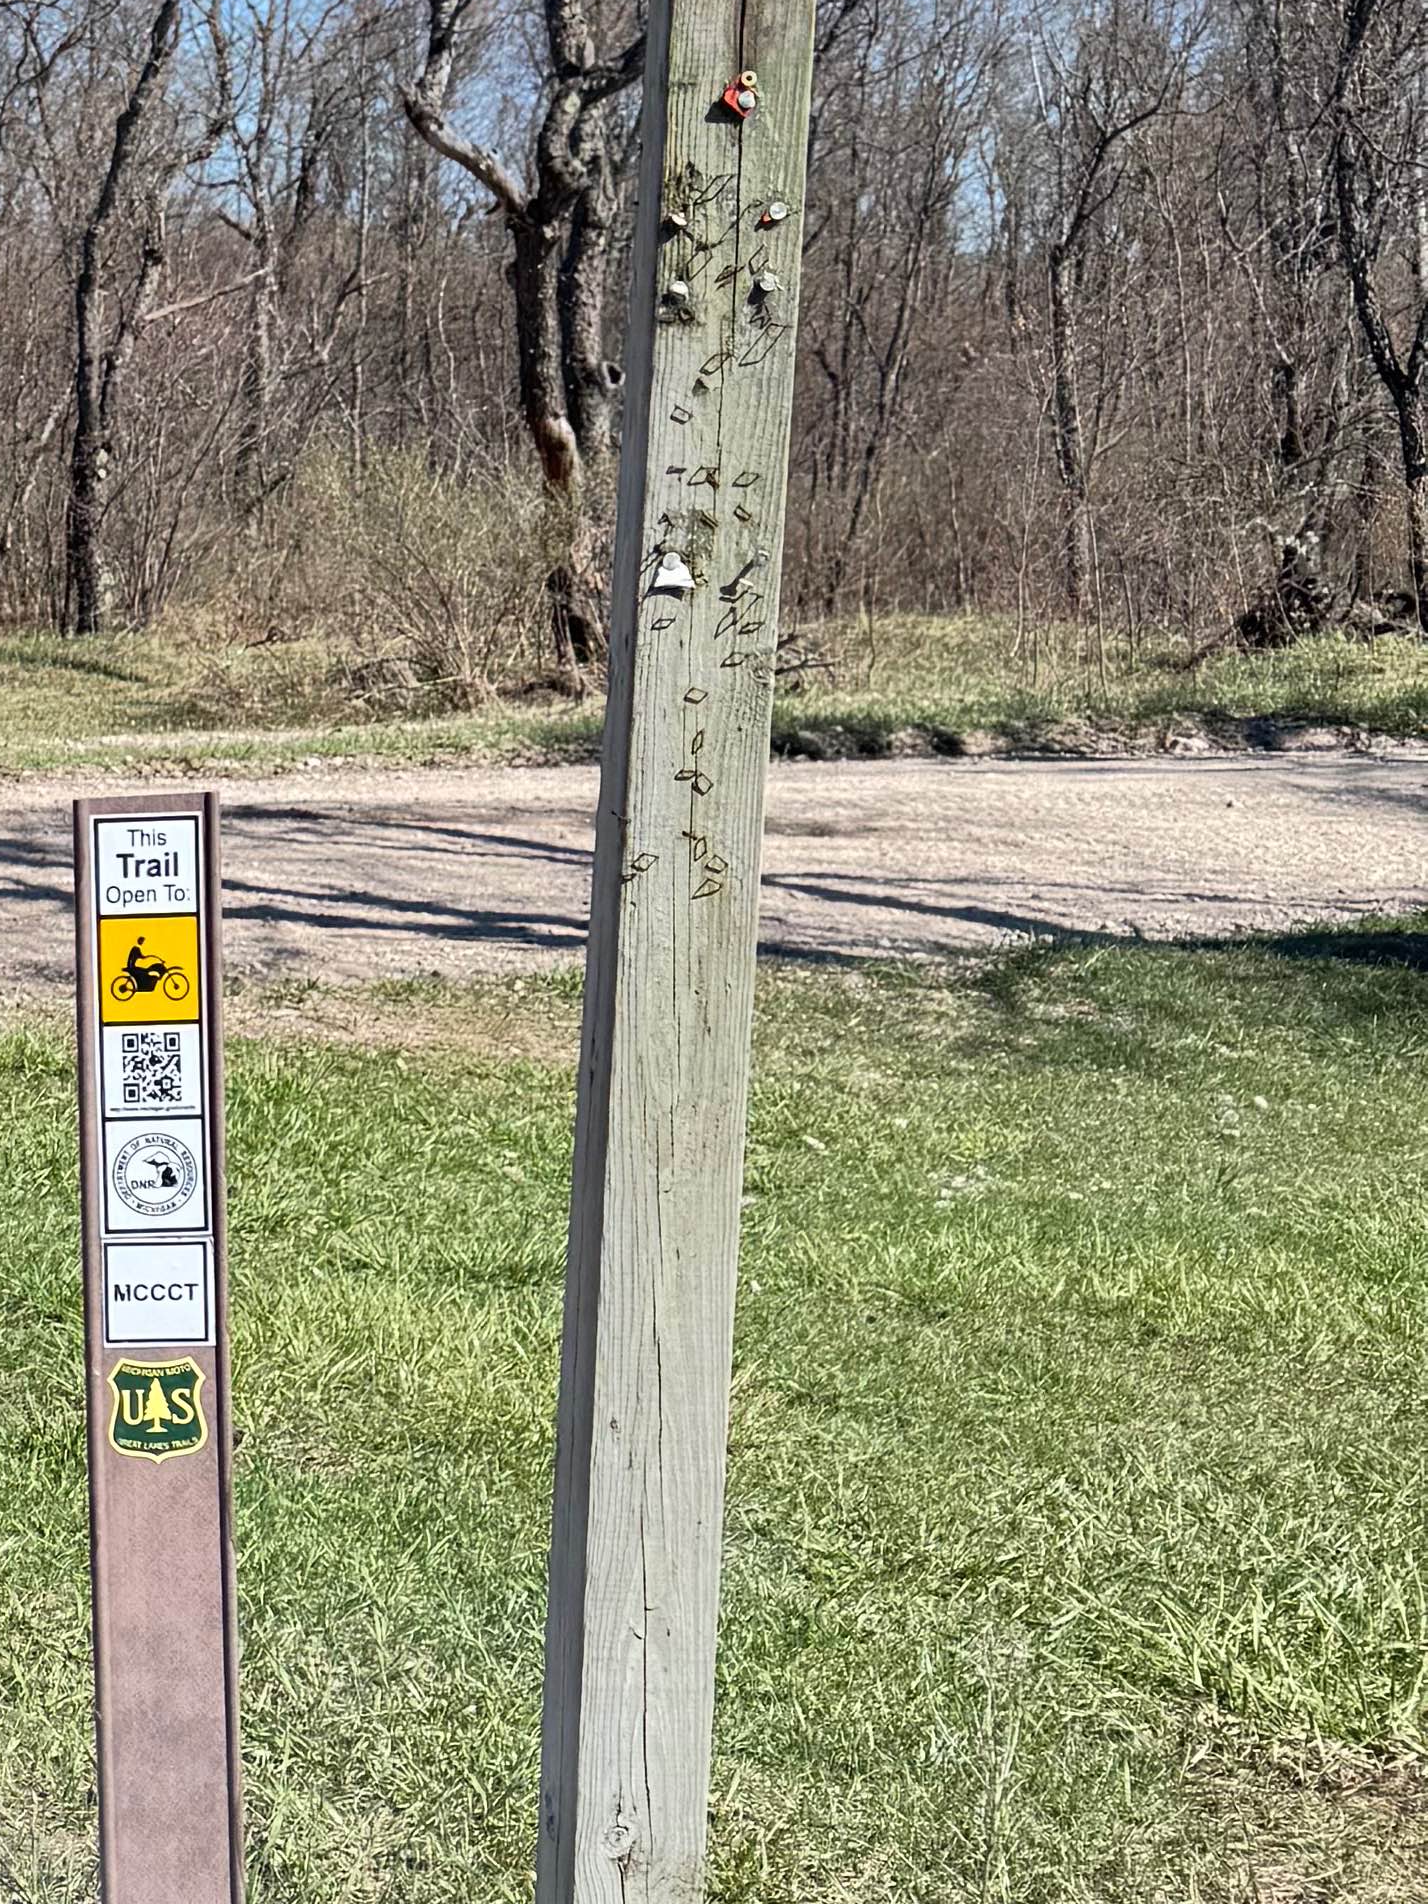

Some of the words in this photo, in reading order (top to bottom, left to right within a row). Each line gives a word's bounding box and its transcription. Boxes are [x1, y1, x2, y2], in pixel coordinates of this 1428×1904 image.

[127, 829, 167, 847] This
[116, 852, 179, 878] Trail
[106, 886, 157, 907] Open
[163, 885, 191, 901] To:
[130, 1140, 141, 1150] OF
[130, 1180, 156, 1189] DNR
[114, 1283, 199, 1302] MCCCT
[121, 1364, 164, 1377] MICHIGAN
[165, 1363, 191, 1375] MOTO
[118, 1438, 142, 1449] GREAT
